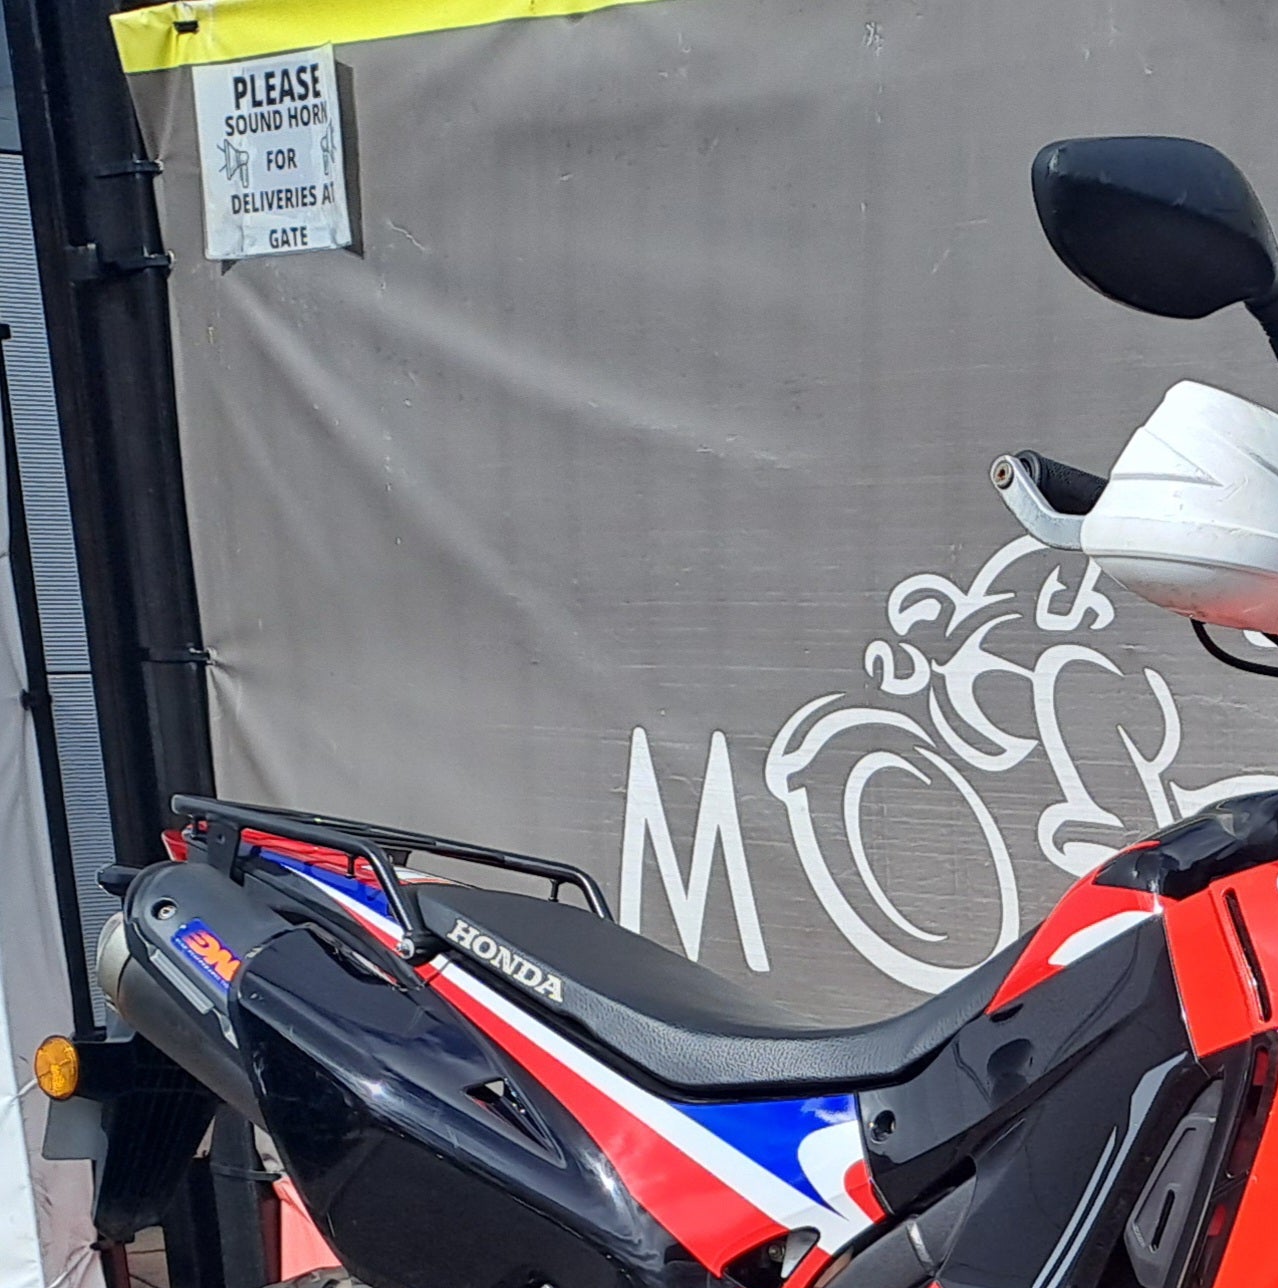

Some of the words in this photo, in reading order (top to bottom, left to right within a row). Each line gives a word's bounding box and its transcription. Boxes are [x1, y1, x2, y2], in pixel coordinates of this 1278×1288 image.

[233, 63, 322, 110] PLEASE
[225, 110, 283, 136] SOUND
[288, 101, 328, 128] HORN
[266, 148, 297, 171] FOR
[231, 185, 317, 214] DELIVERIES
[269, 226, 308, 249] GATE
[446, 919, 564, 1002] HONDA
